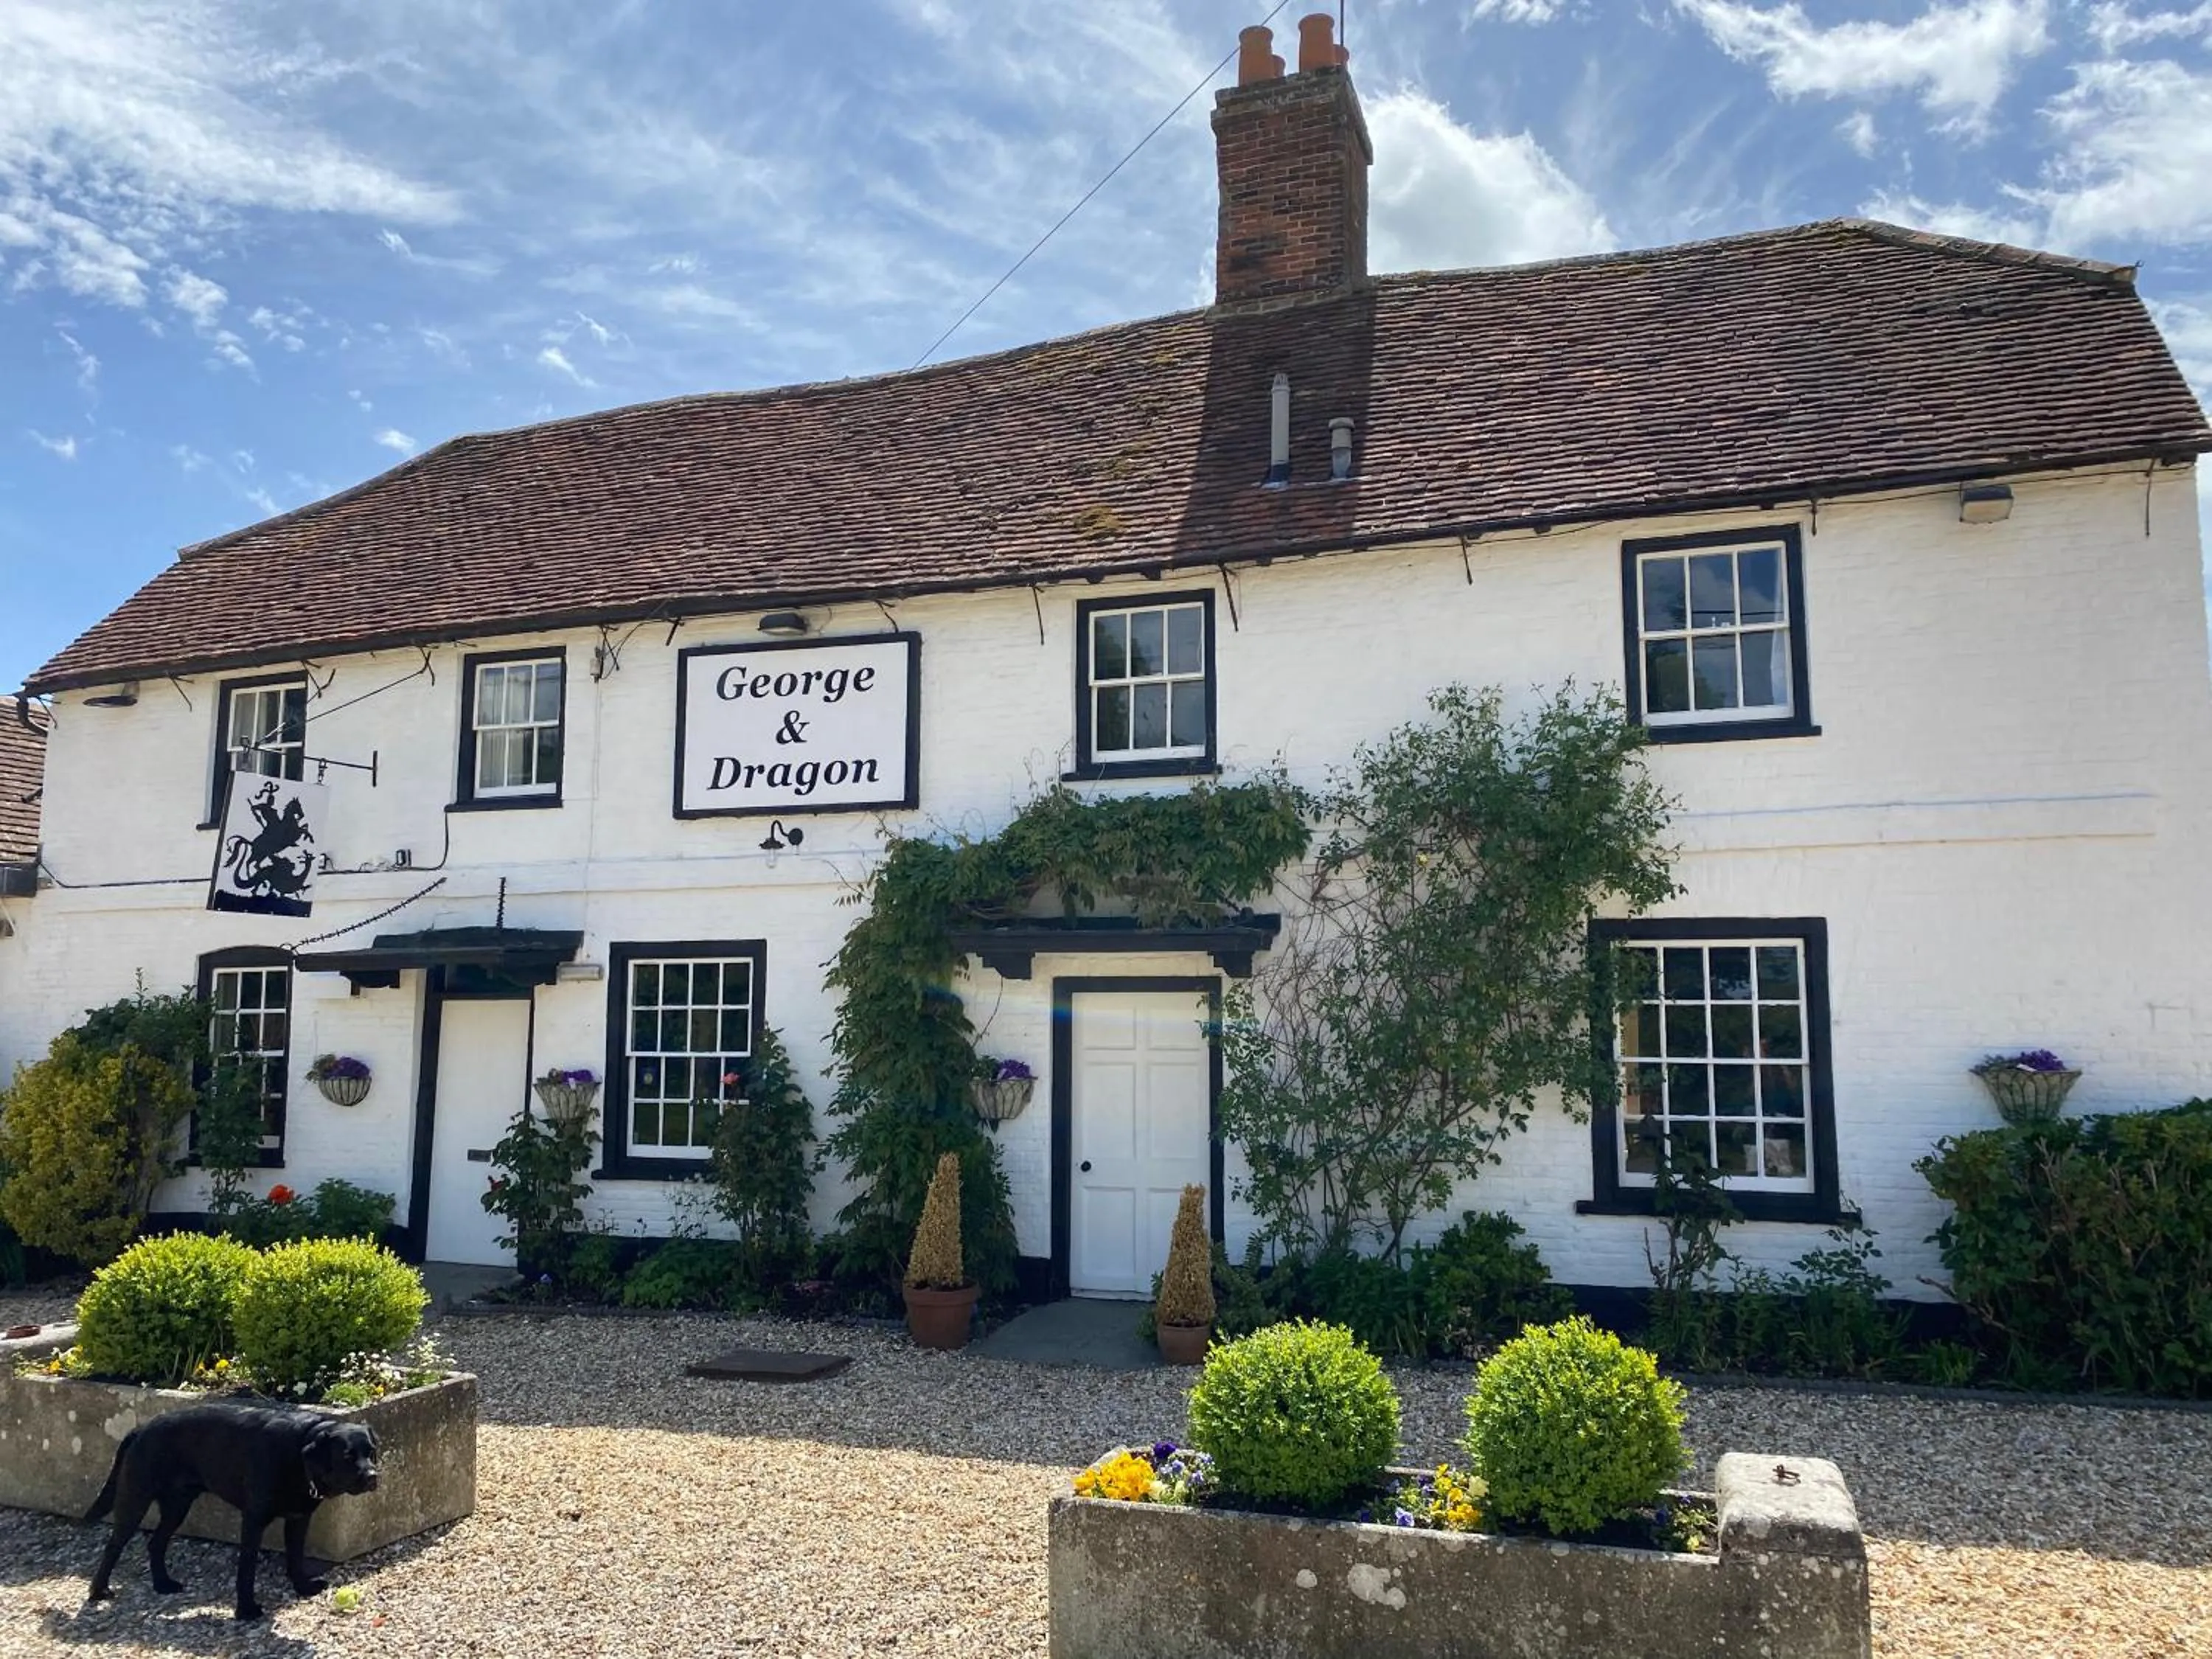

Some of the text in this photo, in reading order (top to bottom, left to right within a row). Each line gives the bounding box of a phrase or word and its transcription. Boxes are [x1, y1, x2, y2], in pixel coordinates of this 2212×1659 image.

[716, 666, 875, 703] George
[775, 710, 810, 745] &
[706, 757, 880, 796] Dragon
